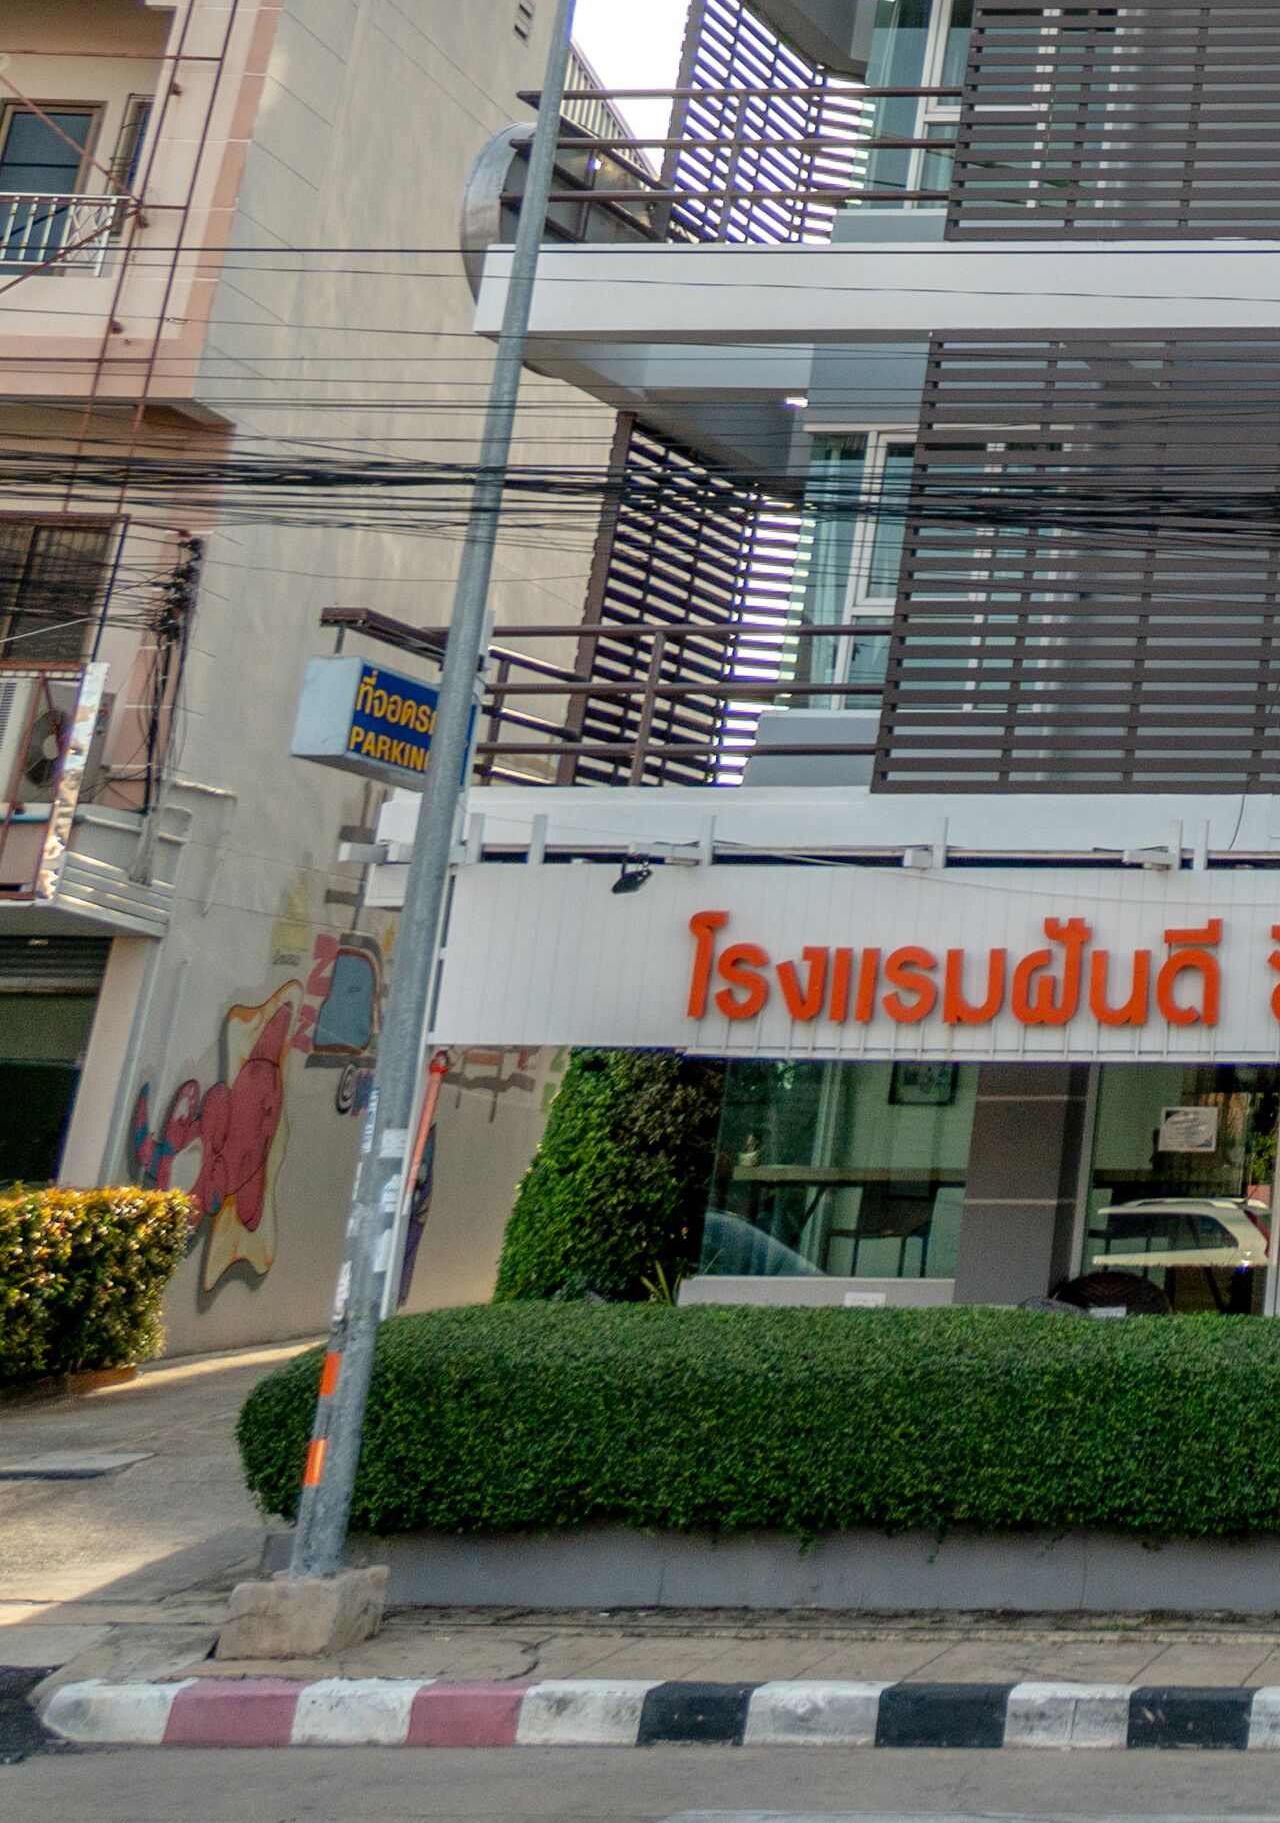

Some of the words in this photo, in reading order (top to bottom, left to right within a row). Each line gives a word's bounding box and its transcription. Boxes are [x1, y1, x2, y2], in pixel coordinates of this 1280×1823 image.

[687, 911, 1223, 1026] โรงแรมฝันดี
